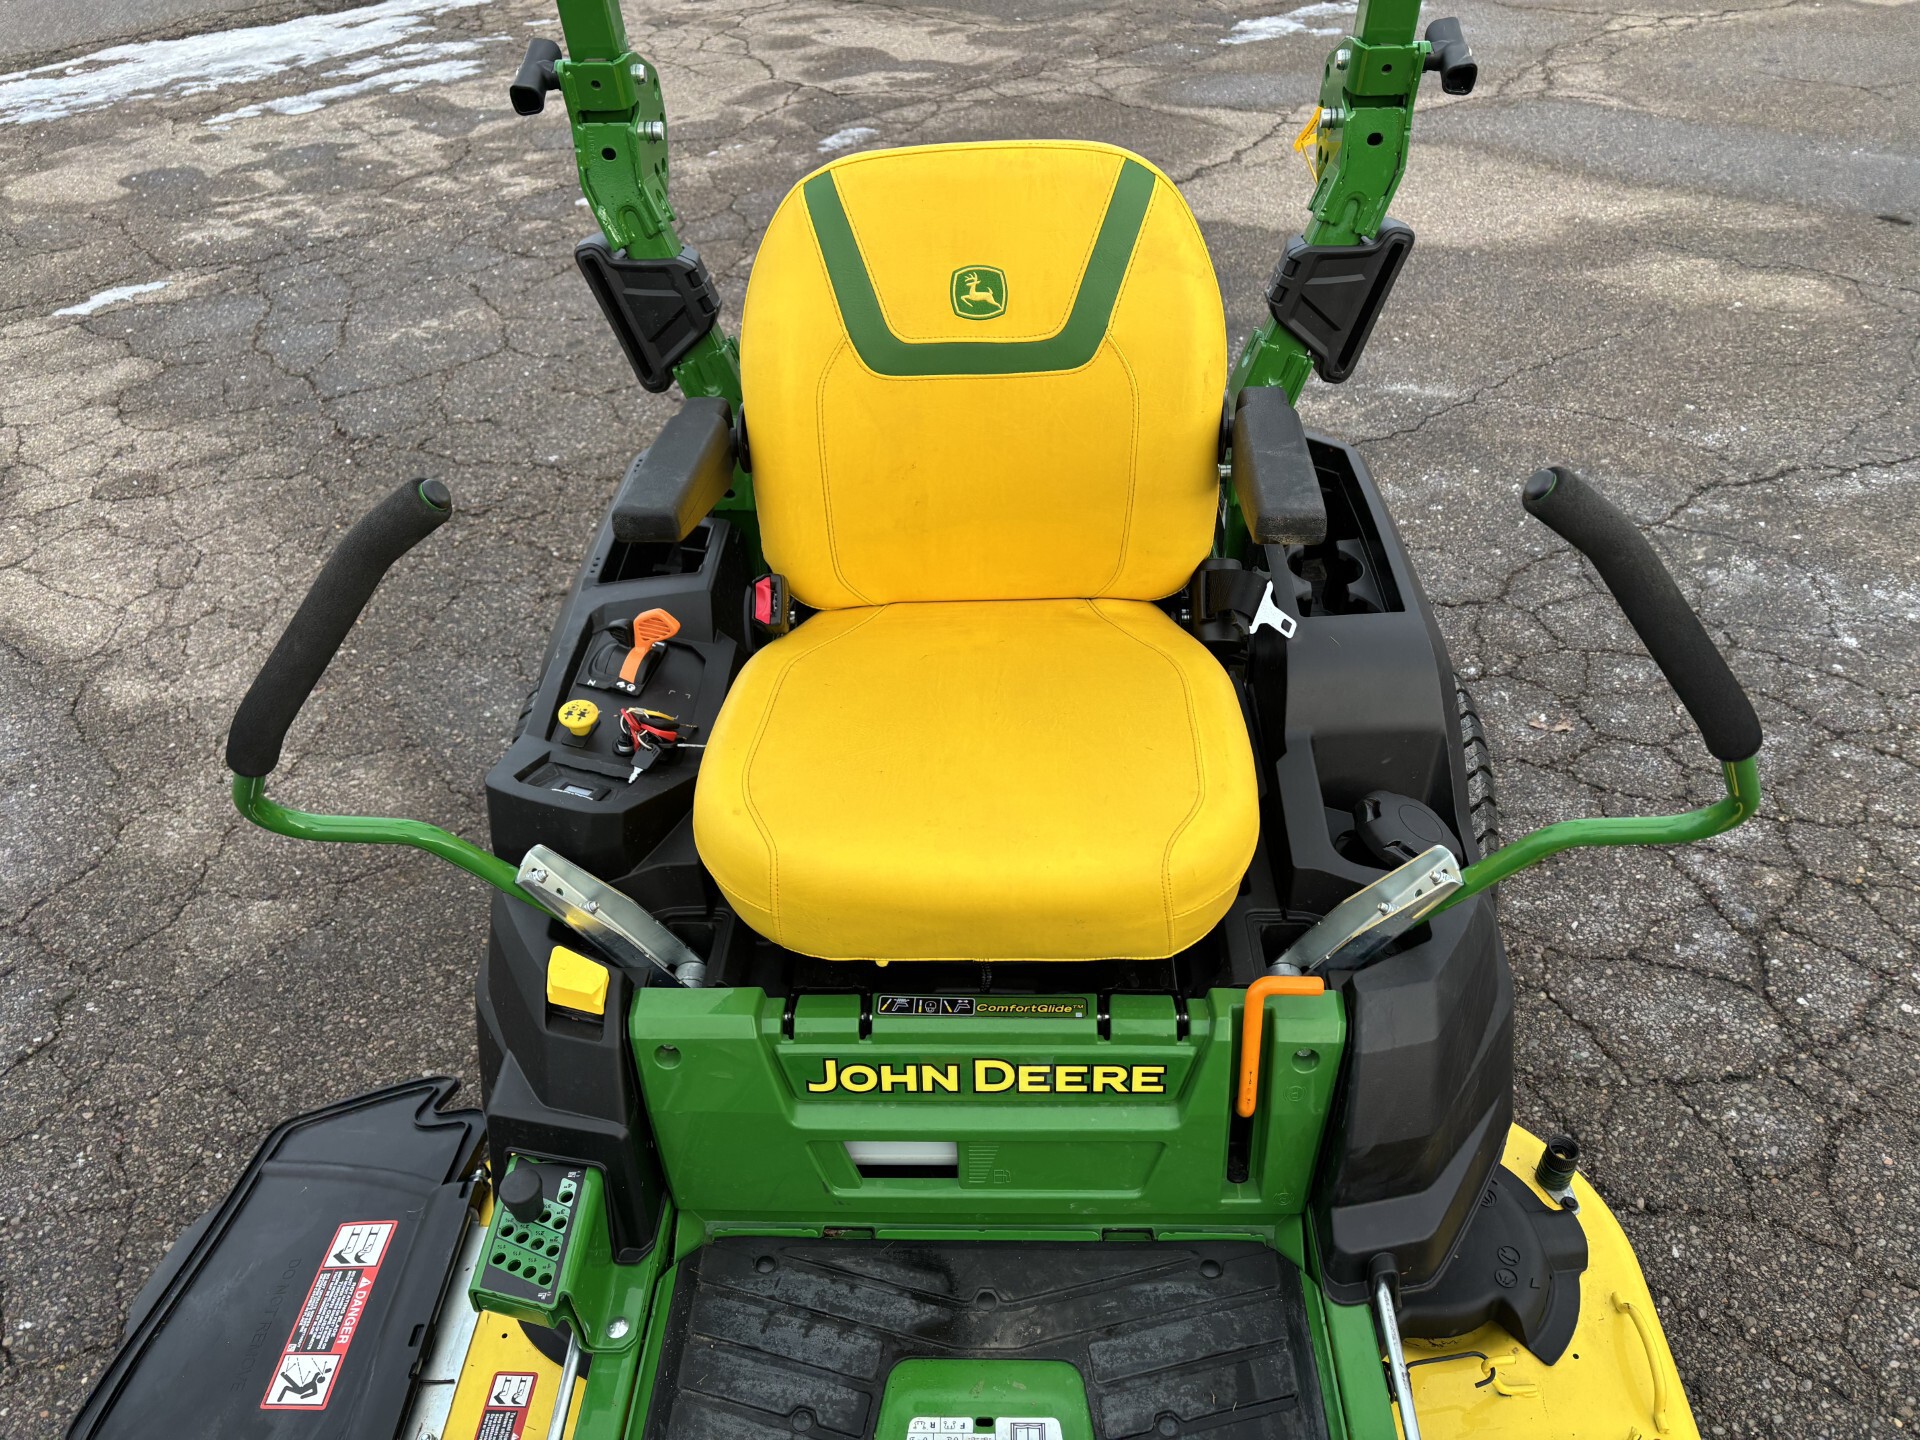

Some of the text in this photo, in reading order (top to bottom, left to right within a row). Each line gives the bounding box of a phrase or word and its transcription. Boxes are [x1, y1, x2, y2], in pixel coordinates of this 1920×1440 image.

[806, 1058, 1167, 1094] JOHN DEERE
[336, 1290, 367, 1343] DANGER
